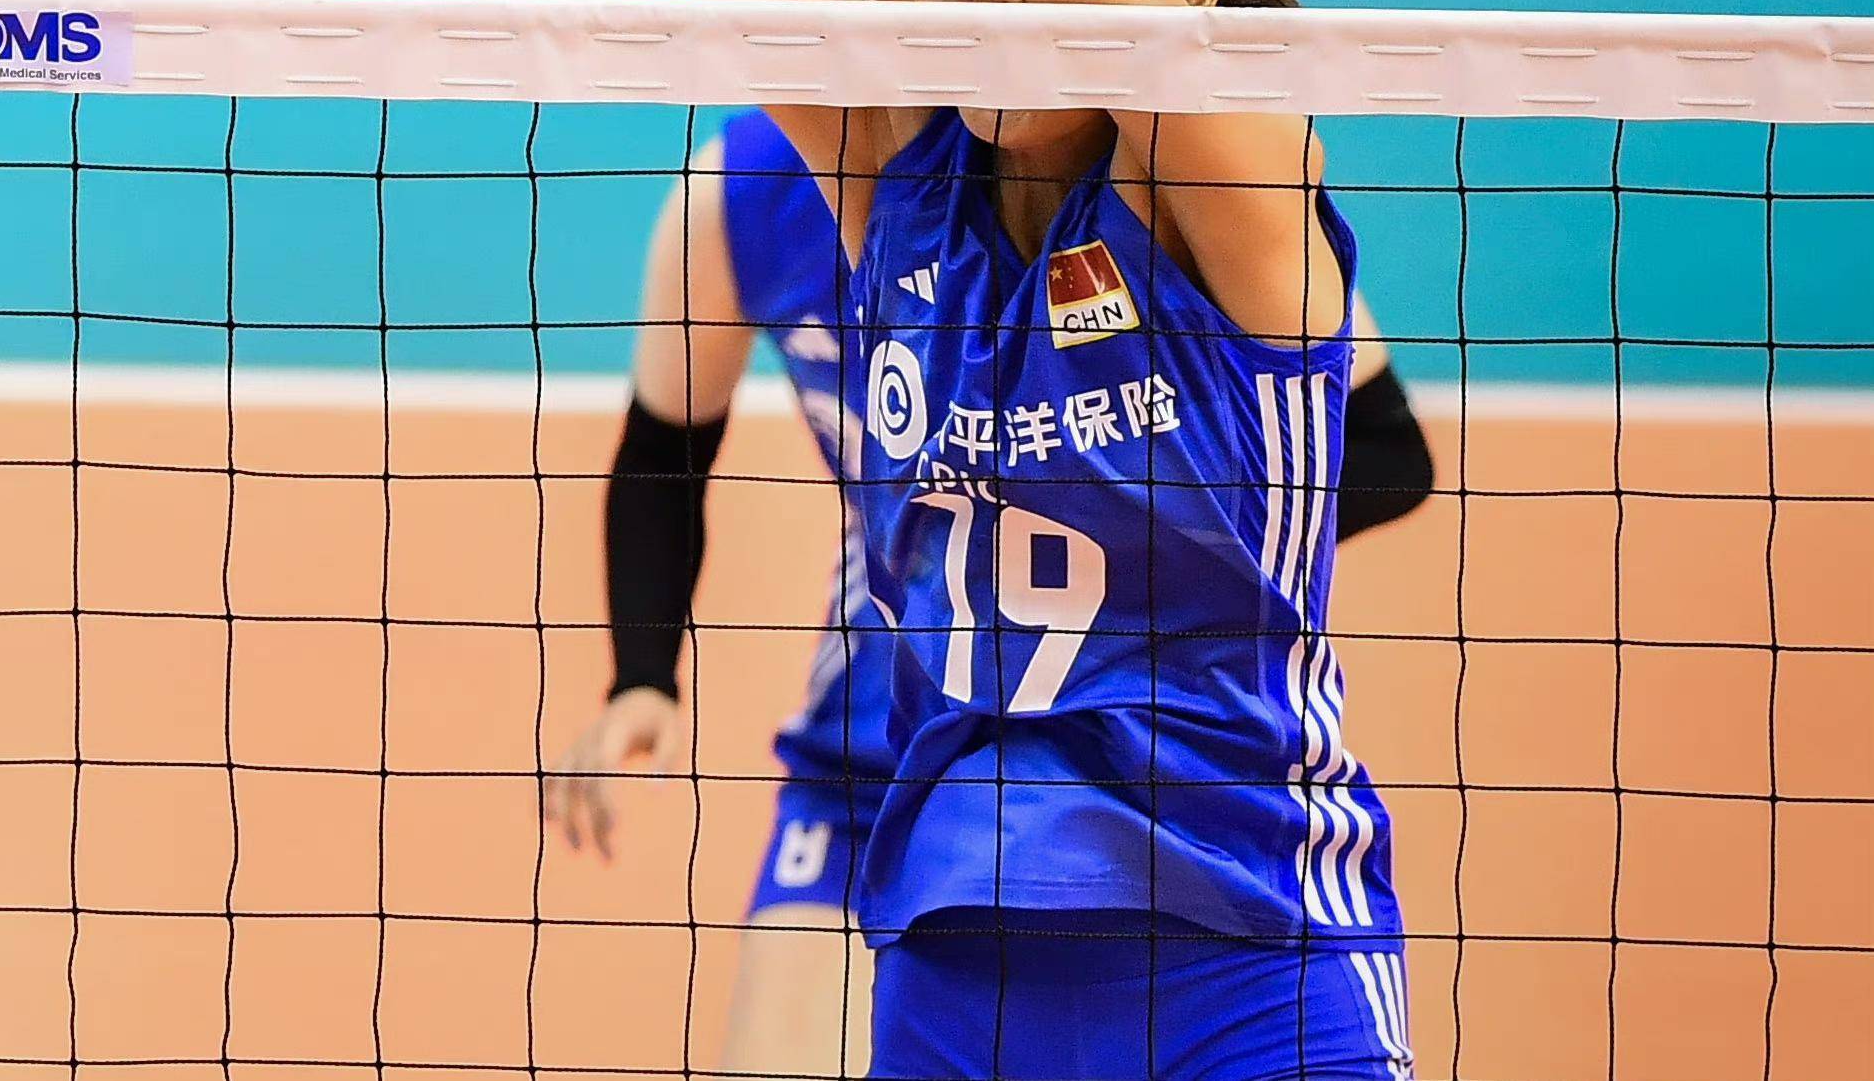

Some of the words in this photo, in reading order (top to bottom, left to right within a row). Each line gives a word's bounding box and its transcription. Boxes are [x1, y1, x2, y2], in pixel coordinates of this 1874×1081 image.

[0, 67, 47, 79] Medical
[49, 69, 102, 81] Services
[1062, 301, 1124, 334] CHN
[910, 491, 1107, 713] 19
